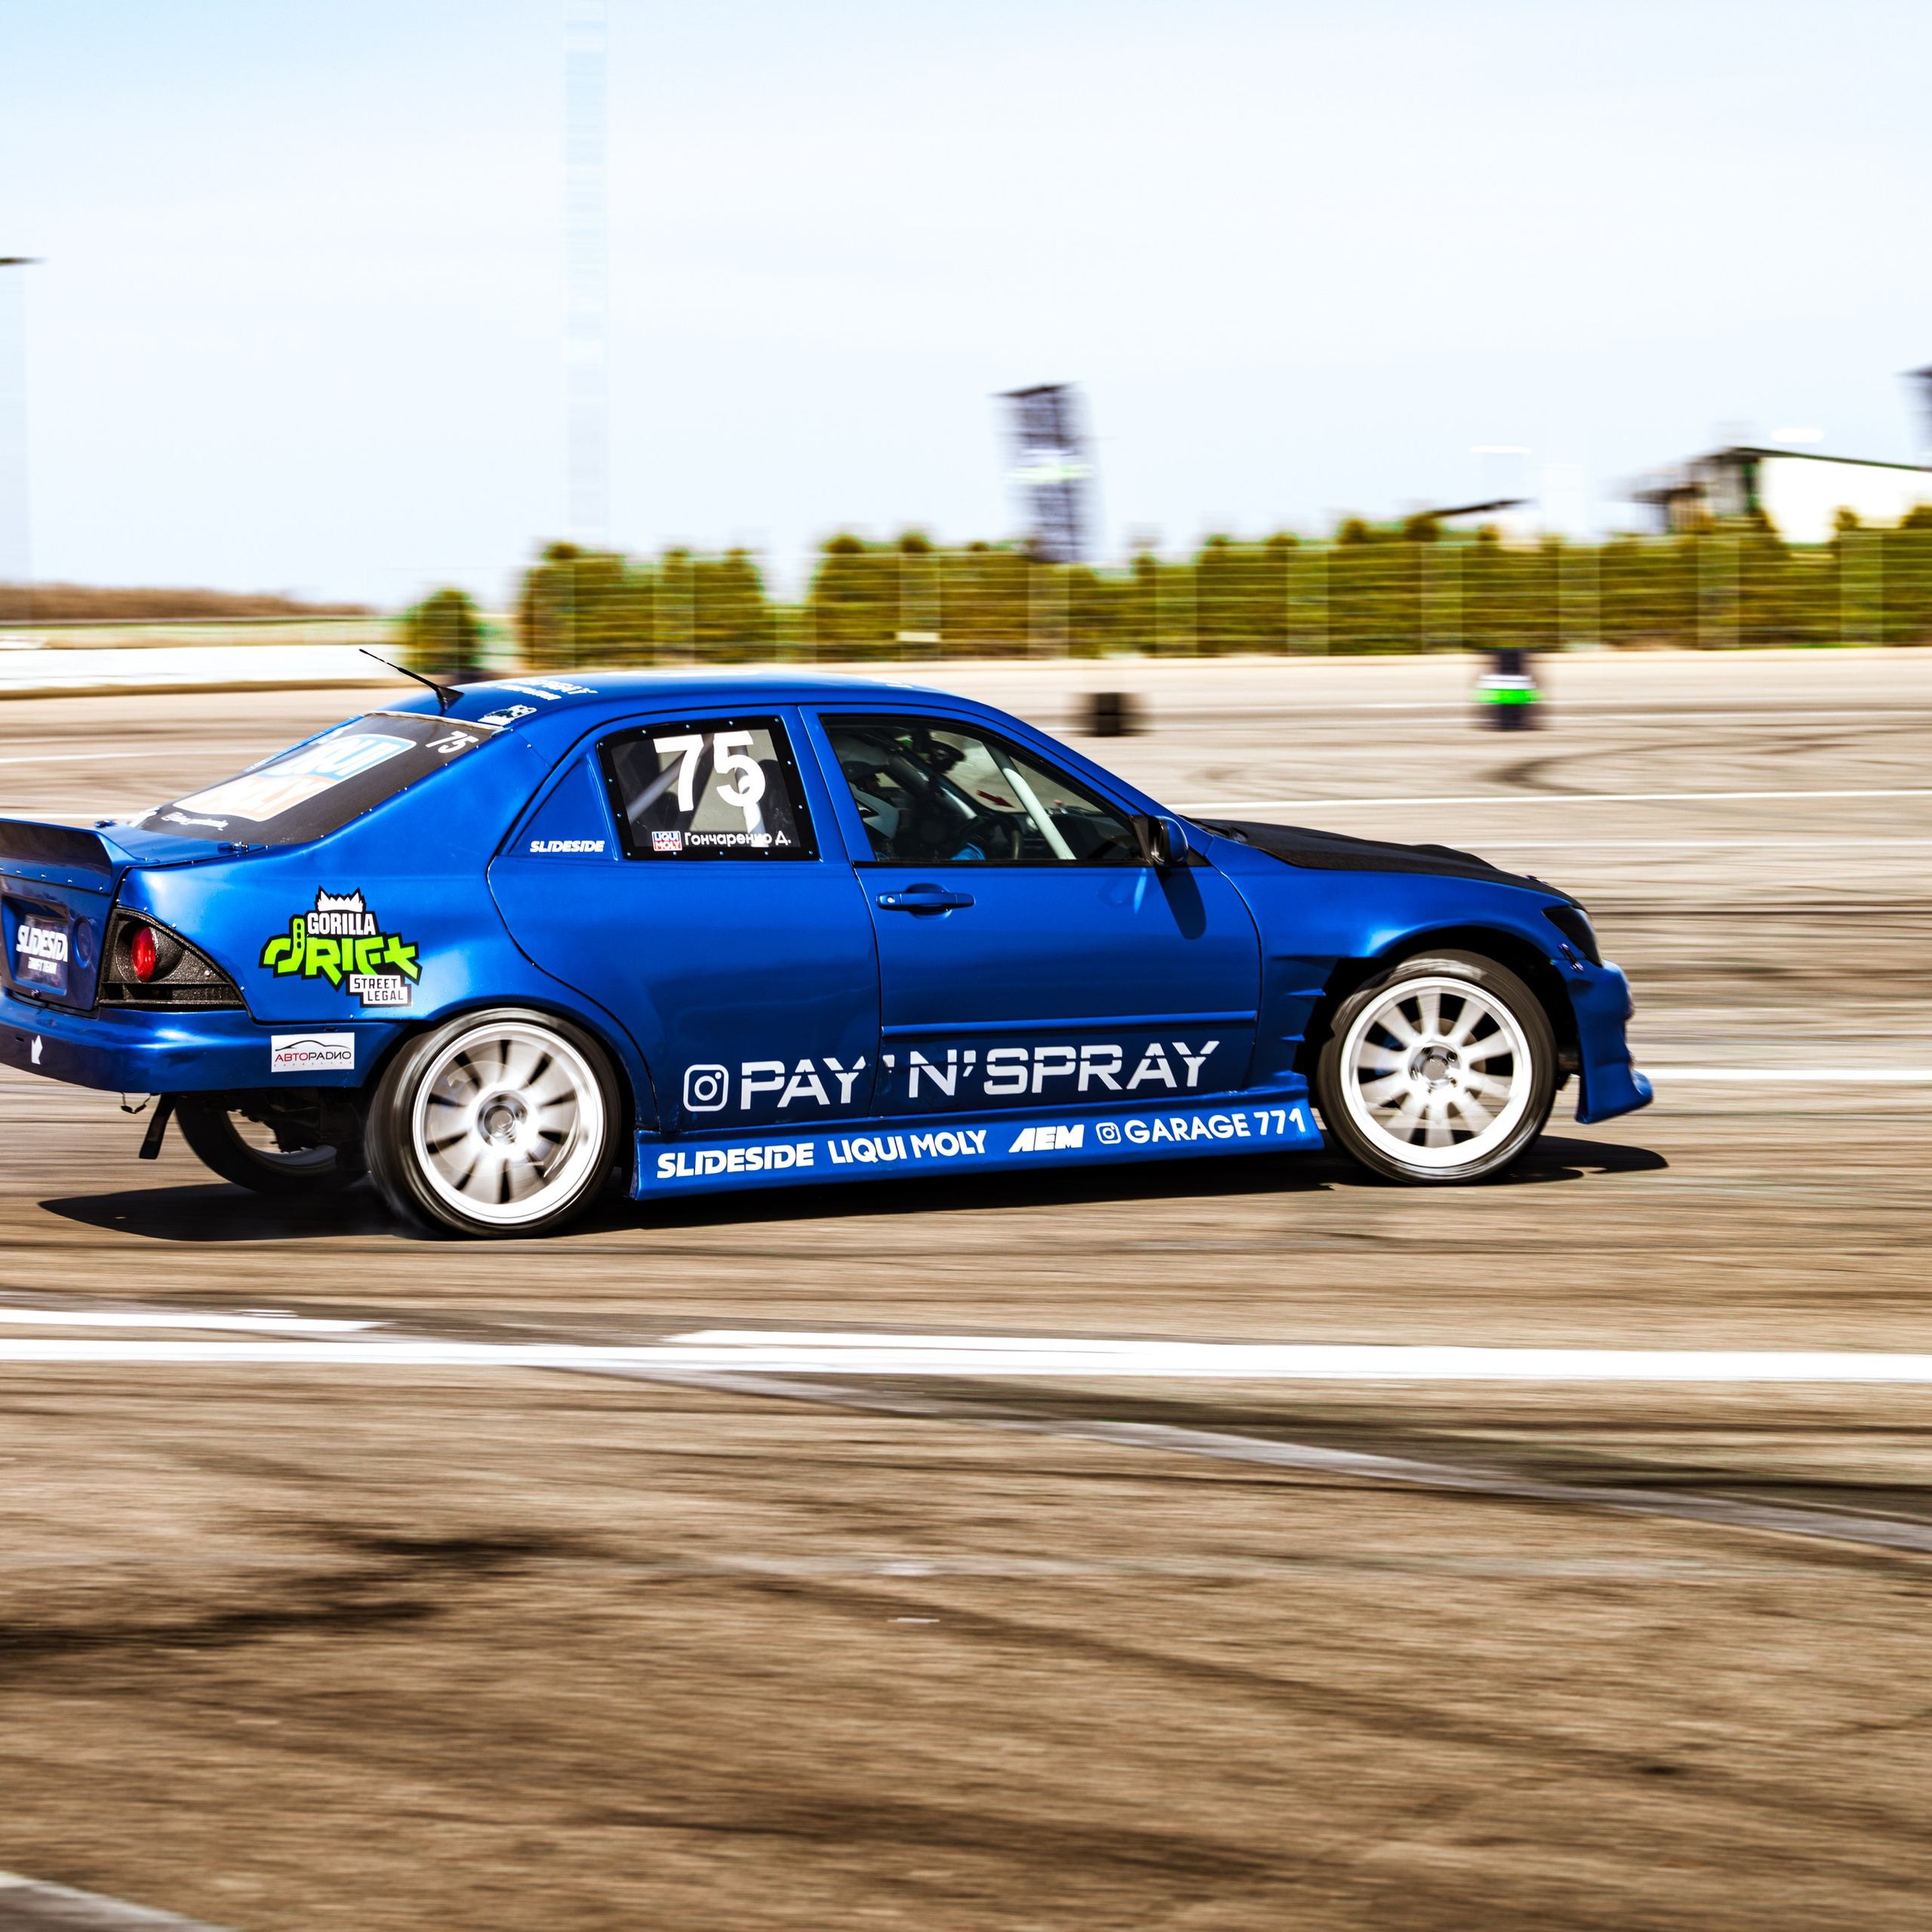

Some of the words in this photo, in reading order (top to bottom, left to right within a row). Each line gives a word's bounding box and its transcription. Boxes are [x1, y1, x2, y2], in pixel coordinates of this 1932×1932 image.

[426, 730, 479, 753] 75
[653, 731, 766, 811] 75
[530, 840, 605, 853] SLIDESIDE
[654, 832, 679, 841] LIQUI
[654, 841, 681, 849] MOLY
[774, 830, 792, 845] Д.
[306, 912, 376, 935] GORILLA
[263, 918, 419, 986] DRIFT
[354, 978, 398, 989] STREET
[368, 989, 404, 1001] LEGAL
[740, 1056, 866, 1110] PAY
[1126, 1113, 1251, 1143] GARAGE
[1253, 1108, 1306, 1135] 771
[827, 1136, 907, 1164] LIQUI
[909, 1129, 987, 1158] MOLY
[1008, 1124, 1085, 1153] AEM
[657, 1143, 814, 1179] SLIDESIDE
